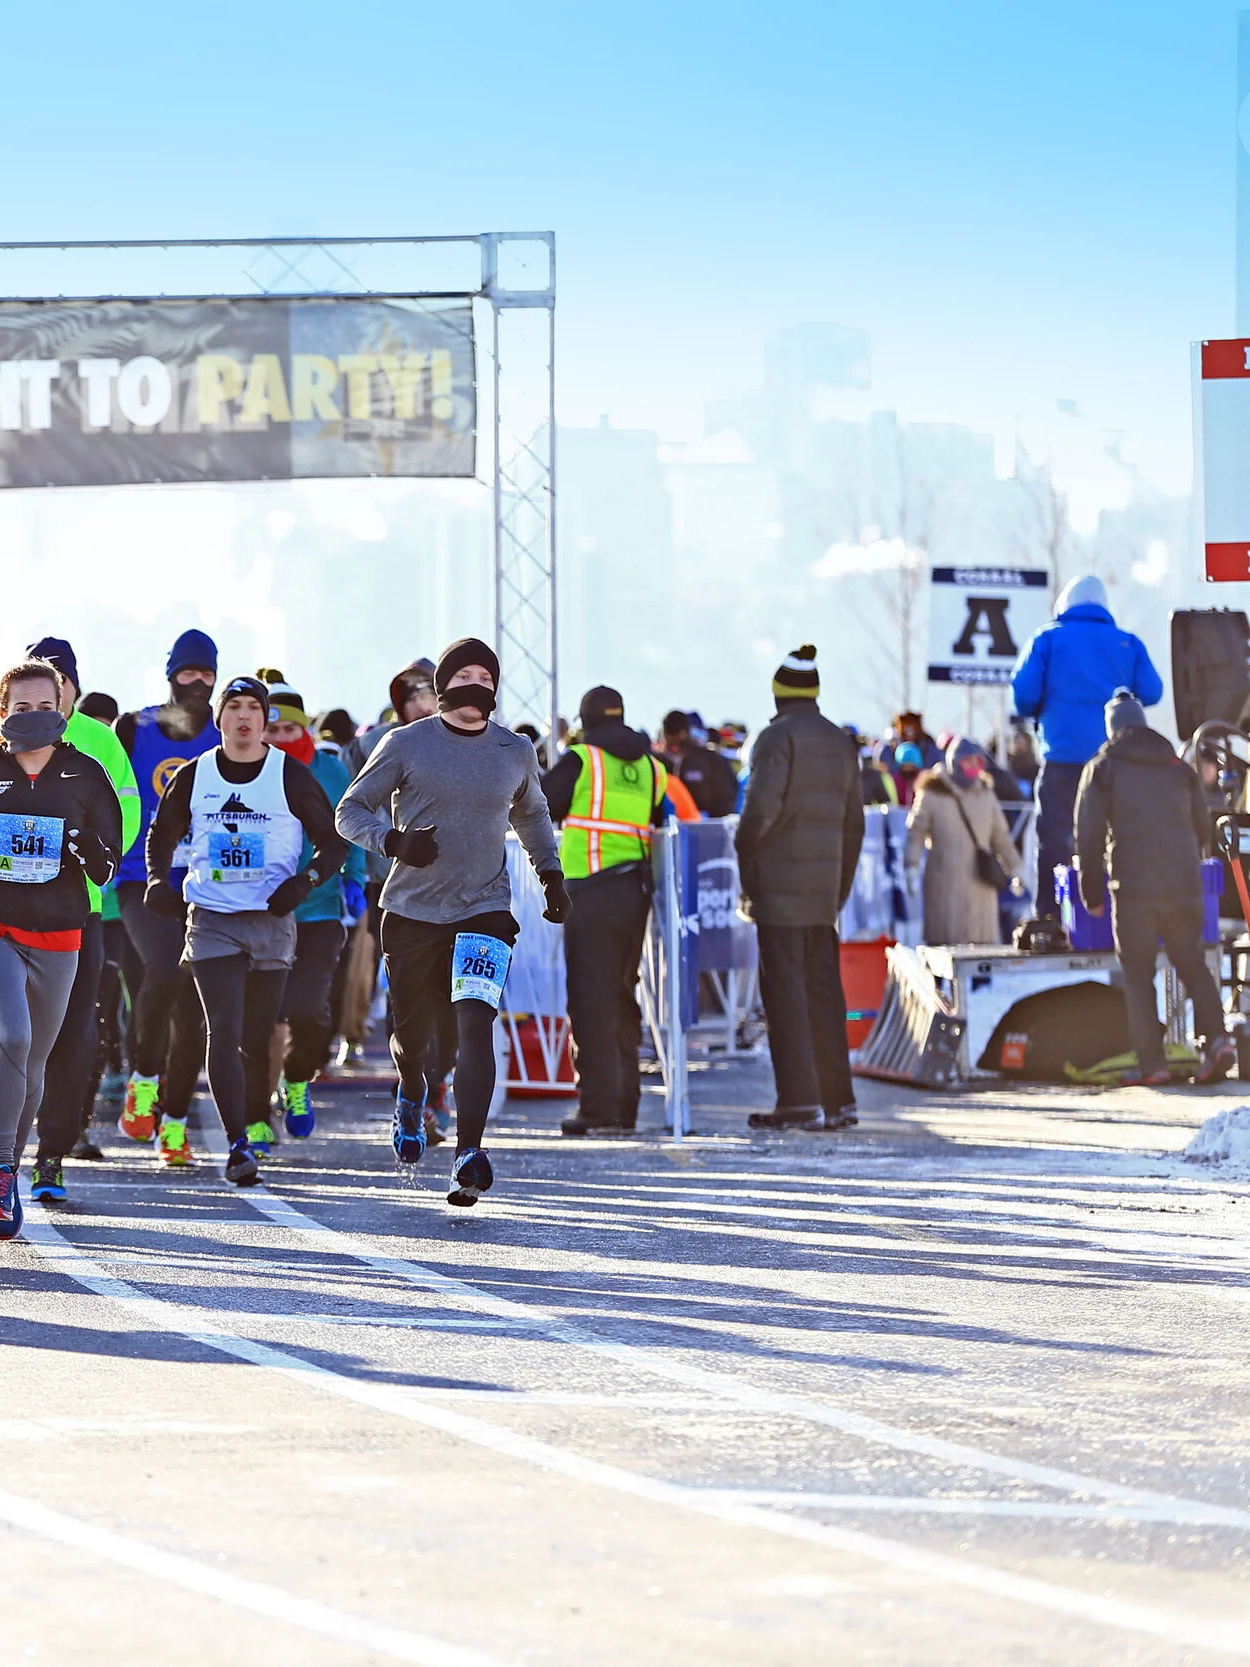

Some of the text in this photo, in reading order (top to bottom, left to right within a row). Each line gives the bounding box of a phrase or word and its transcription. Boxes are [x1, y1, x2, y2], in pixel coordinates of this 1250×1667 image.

[78, 355, 172, 427] TO
[196, 349, 453, 424] PARTY!
[953, 597, 1018, 656] A
[203, 812, 271, 821] PITTSBURGH
[11, 834, 45, 856] 541
[0, 857, 10, 869] A
[220, 849, 251, 868] 561
[461, 957, 497, 979] 265
